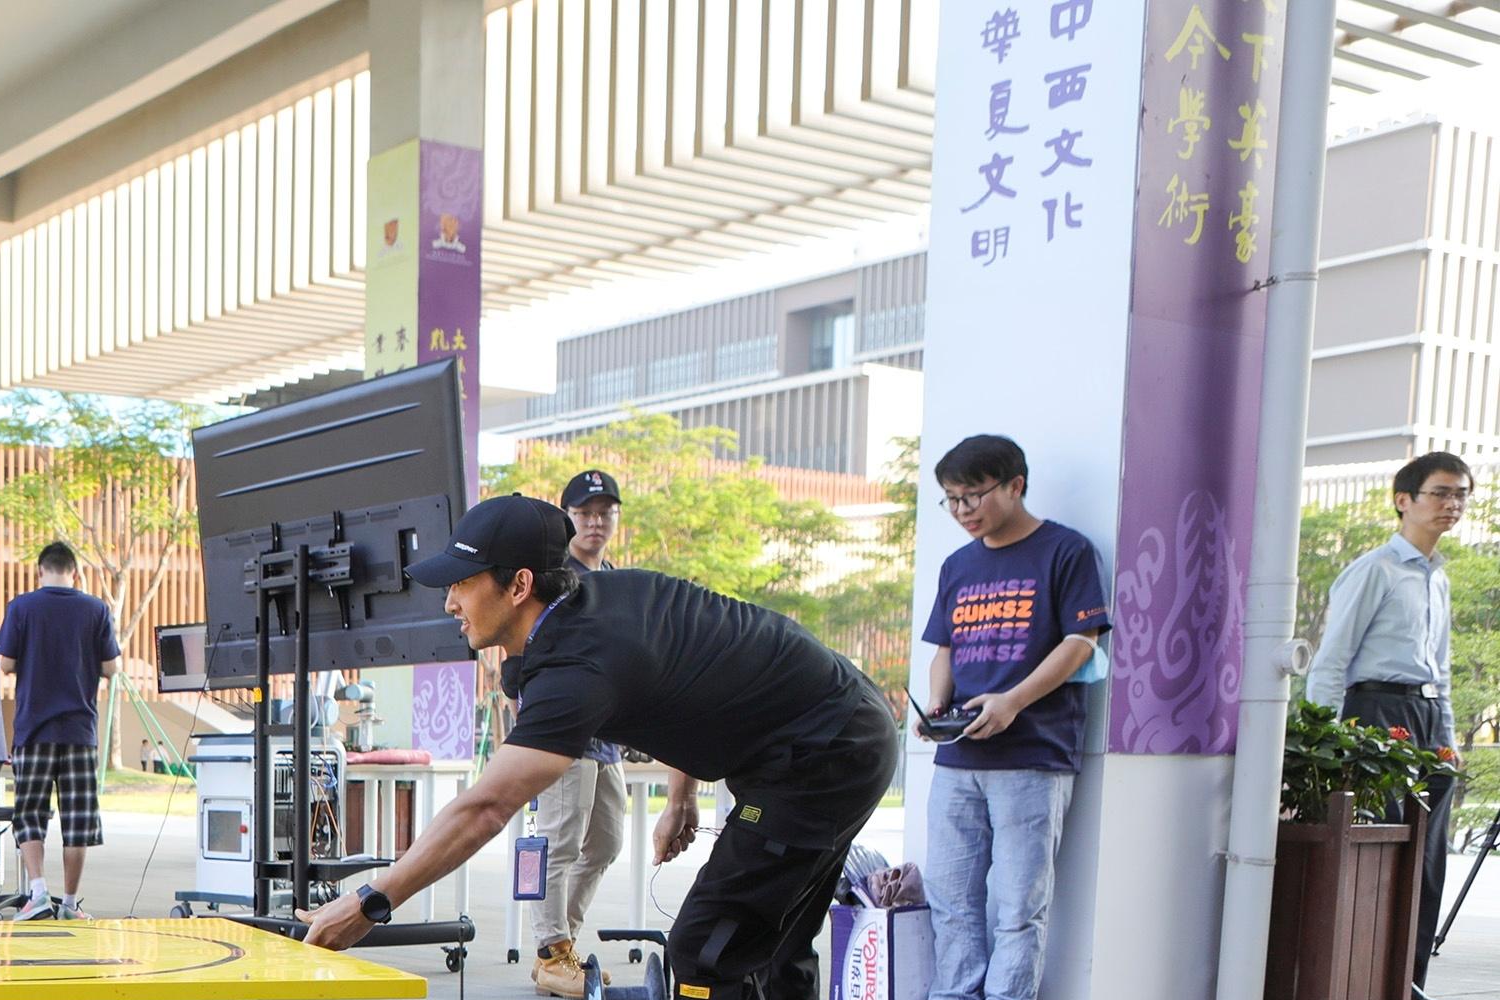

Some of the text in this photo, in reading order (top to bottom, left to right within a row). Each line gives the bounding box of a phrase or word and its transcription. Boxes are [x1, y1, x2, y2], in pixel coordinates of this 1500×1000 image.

[1040, 0, 1095, 244] 中西文化
[1228, 0, 1279, 264] 下英豪
[960, 7, 1029, 267] 華夏文明
[957, 579, 1037, 605] CUHKSZ
[952, 600, 1034, 625] CUHKSZ
[952, 621, 1031, 644] CUHKSZ
[955, 643, 1029, 666] CUHKSZ
